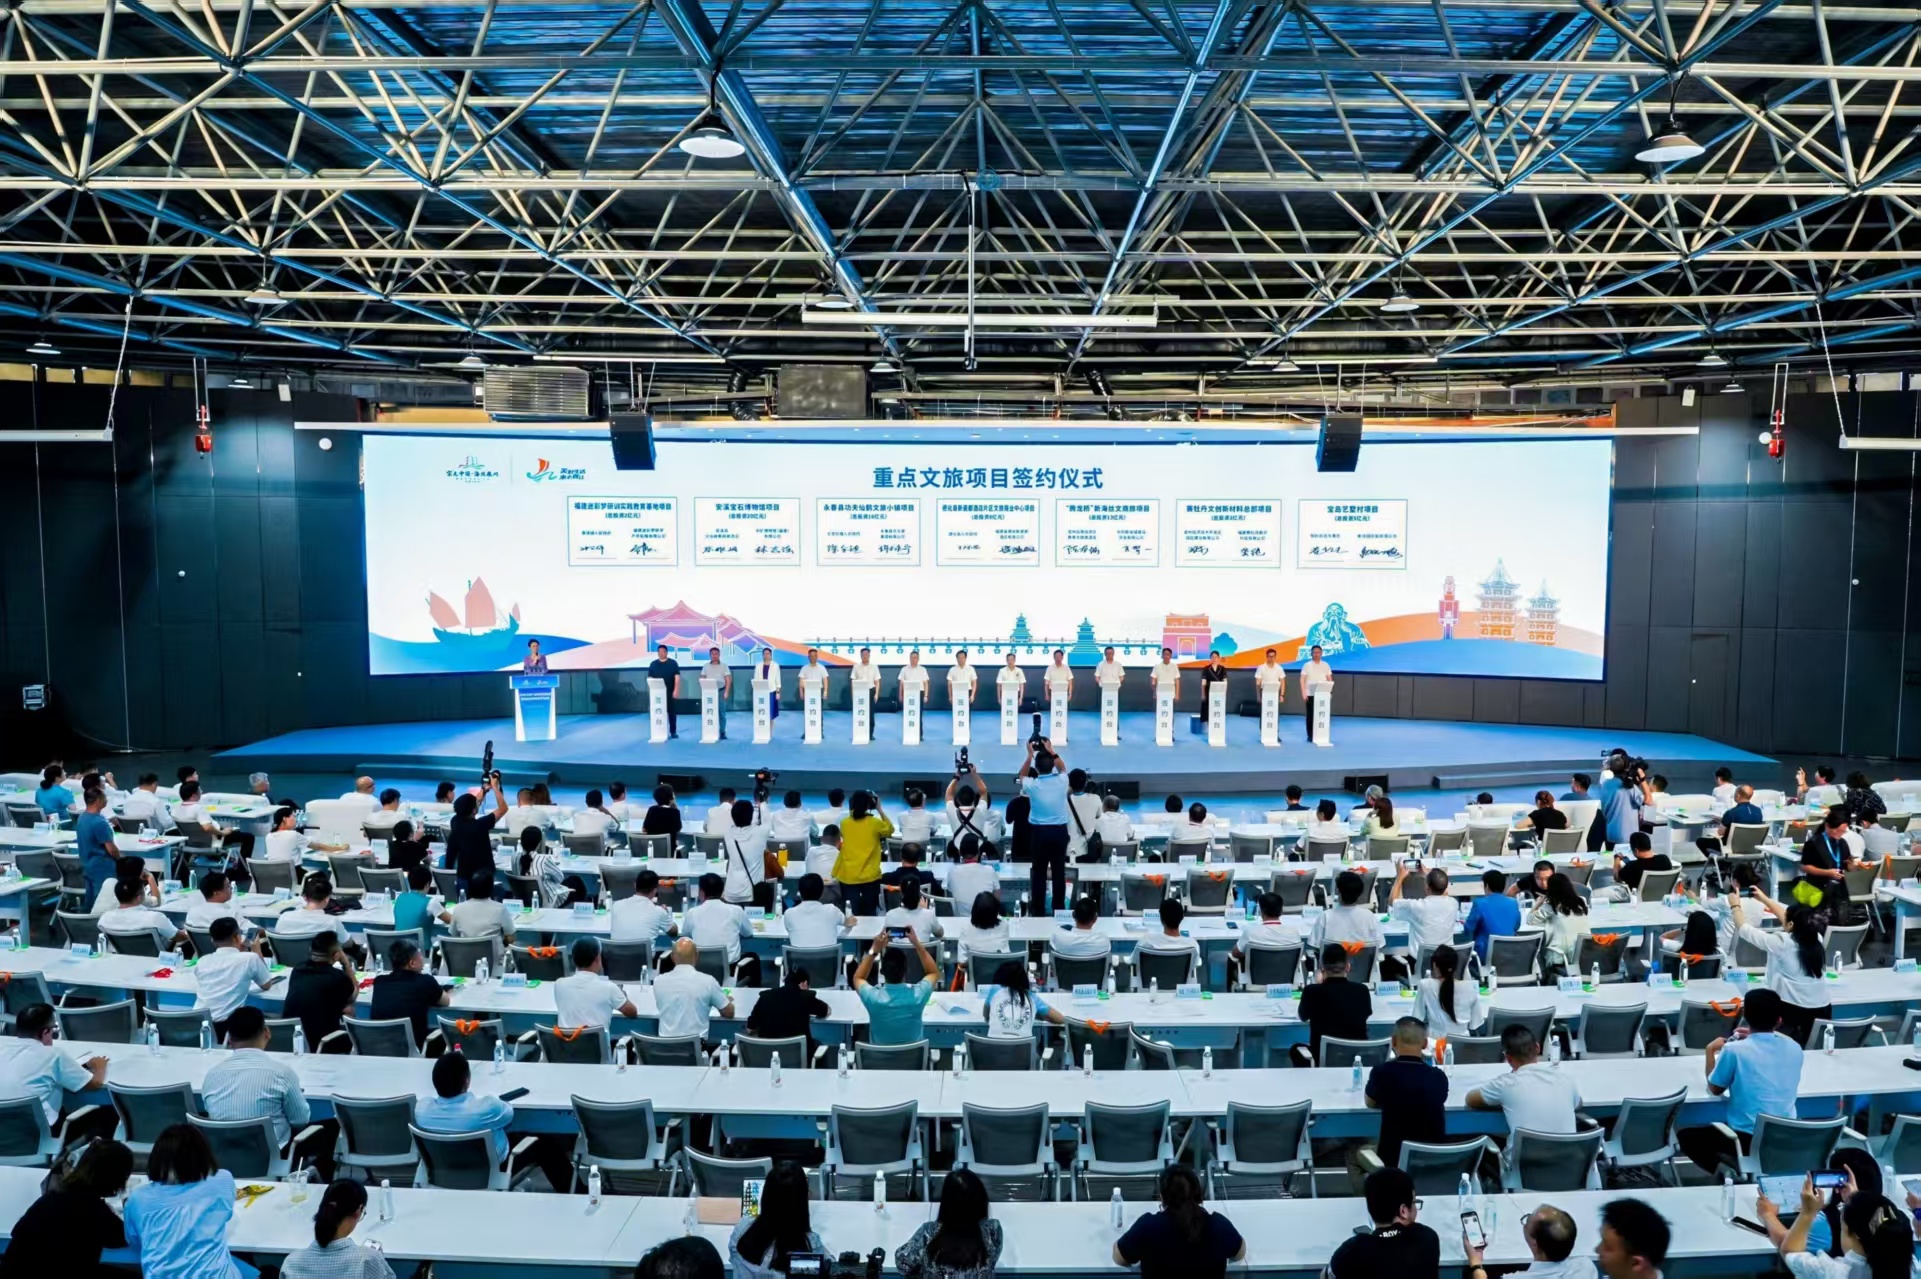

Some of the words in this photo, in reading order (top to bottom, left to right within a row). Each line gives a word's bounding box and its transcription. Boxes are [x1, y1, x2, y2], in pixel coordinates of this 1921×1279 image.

[873, 467, 1103, 489] 重点文旅项目签约仪式
[715, 503, 780, 511] 安溪宝石博物馆项目
